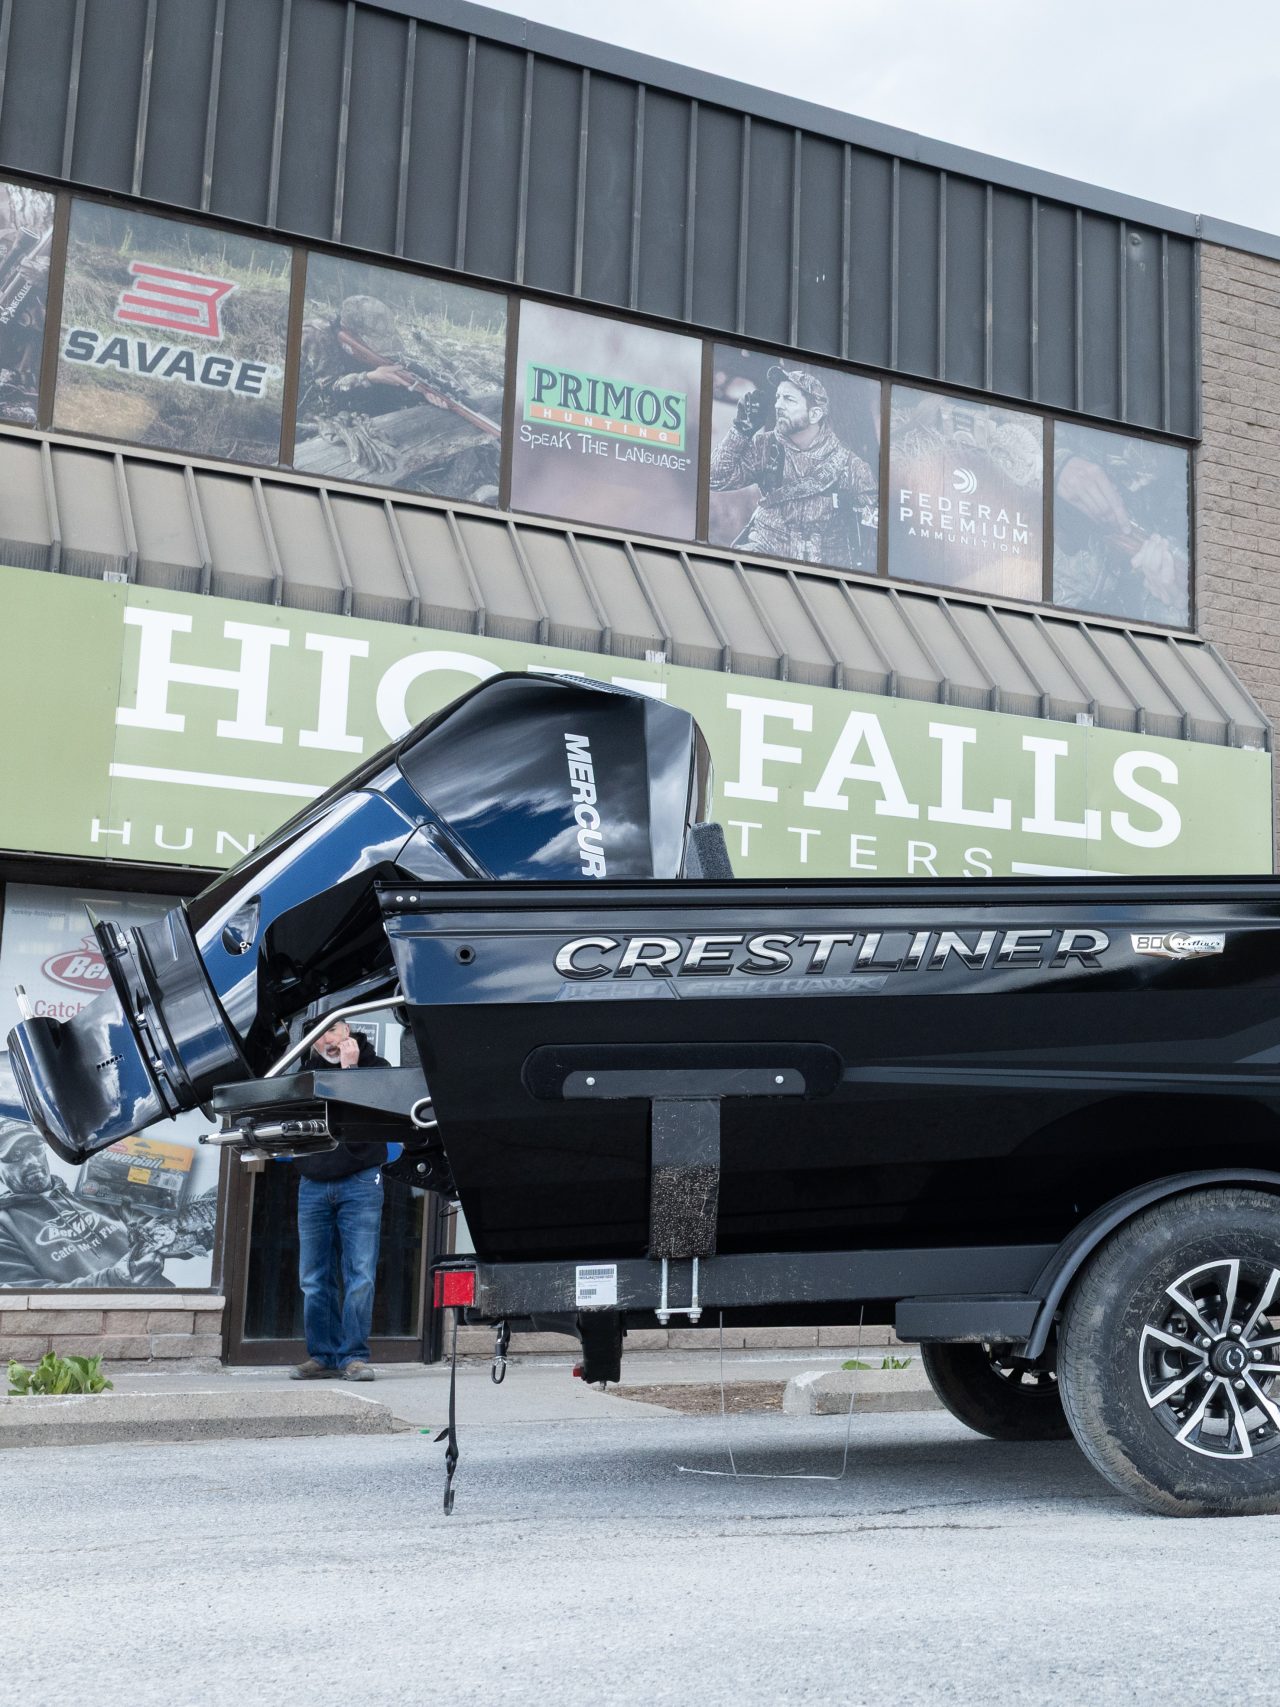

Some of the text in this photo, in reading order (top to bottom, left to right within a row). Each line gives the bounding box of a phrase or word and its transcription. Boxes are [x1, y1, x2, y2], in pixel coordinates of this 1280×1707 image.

[65, 329, 267, 394] SAVAGE
[531, 366, 681, 430] PRIMOS
[543, 408, 668, 441] HUNTING
[577, 433, 609, 457] THE
[900, 488, 1028, 528] FEDERAL
[900, 507, 1028, 545] PREMIUM
[908, 527, 1020, 555] AMMUNITION
[115, 606, 1181, 847] HI FALLS
[564, 733, 607, 878] MERCUR
[90, 818, 993, 877] HUN TTERS
[552, 929, 1110, 980] CRESTLINER
[1137, 937, 1163, 949] 80
[61, 955, 110, 980] Ber
